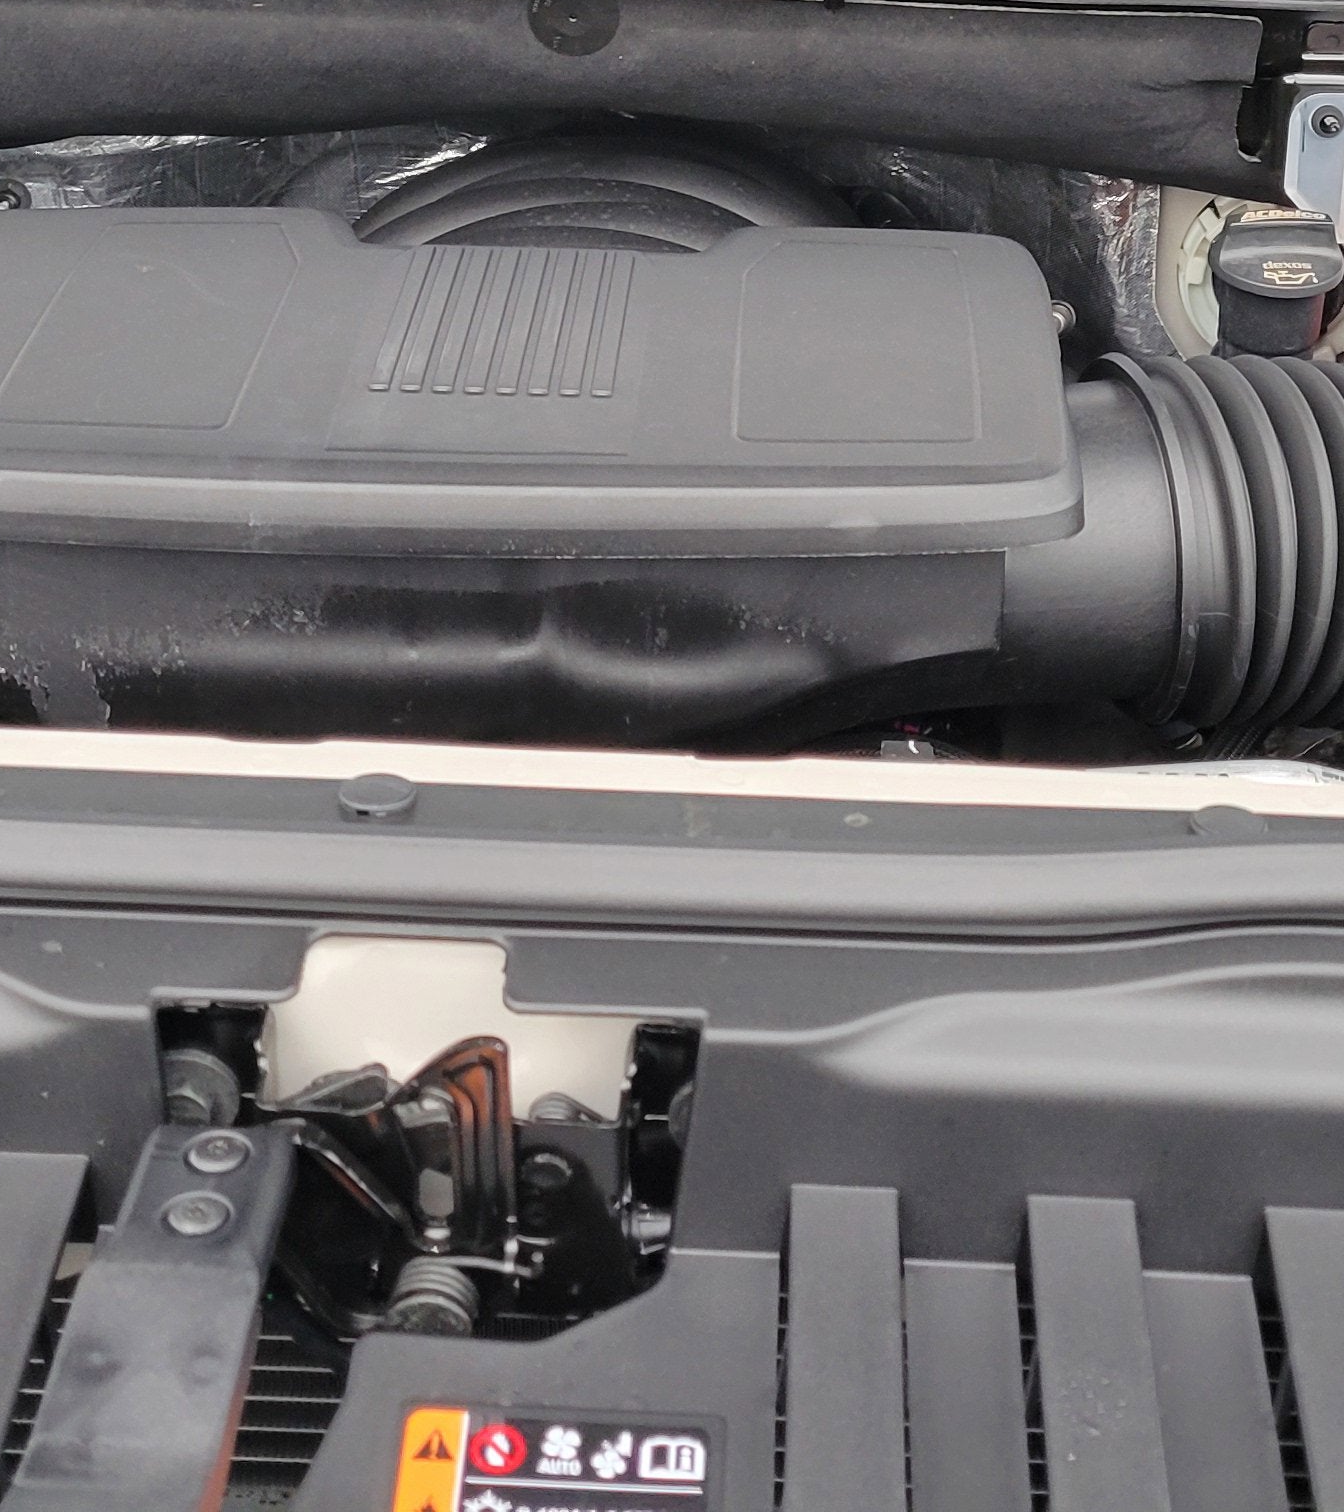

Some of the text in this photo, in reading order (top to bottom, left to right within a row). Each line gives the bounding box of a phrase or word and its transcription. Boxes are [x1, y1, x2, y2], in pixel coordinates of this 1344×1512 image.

[1240, 209, 1327, 223] ACDelco
[1262, 260, 1313, 270] dexos
[535, 1458, 583, 1477] AUTO
